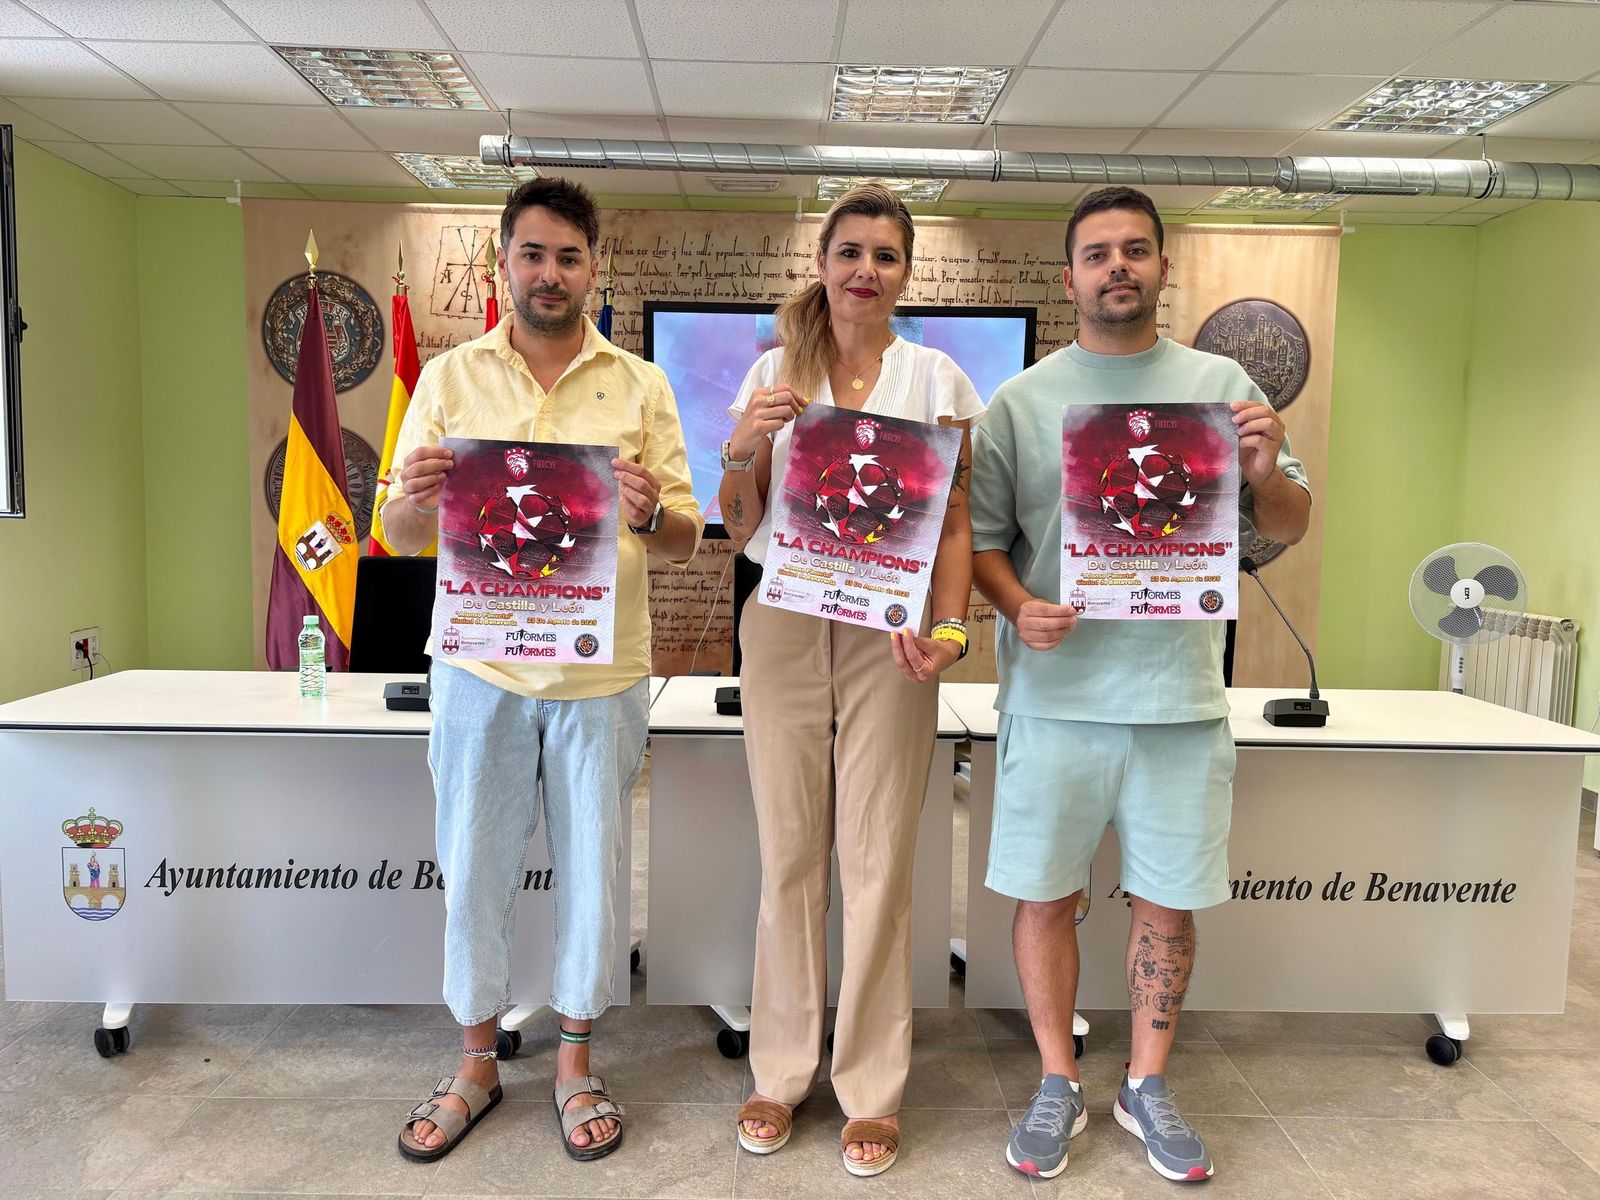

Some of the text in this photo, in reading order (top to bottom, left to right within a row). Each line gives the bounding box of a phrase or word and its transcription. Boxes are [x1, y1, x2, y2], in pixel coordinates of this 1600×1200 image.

[790, 552, 900, 584] De Castilla y León
[1088, 559, 1207, 571] De Castilla y León
[463, 599, 585, 613] De Castilla y León
[144, 856, 358, 897] Ayuntamiento
[369, 860, 403, 890] de
[1321, 871, 1356, 901] de
[1364, 872, 1517, 904] Benavente
